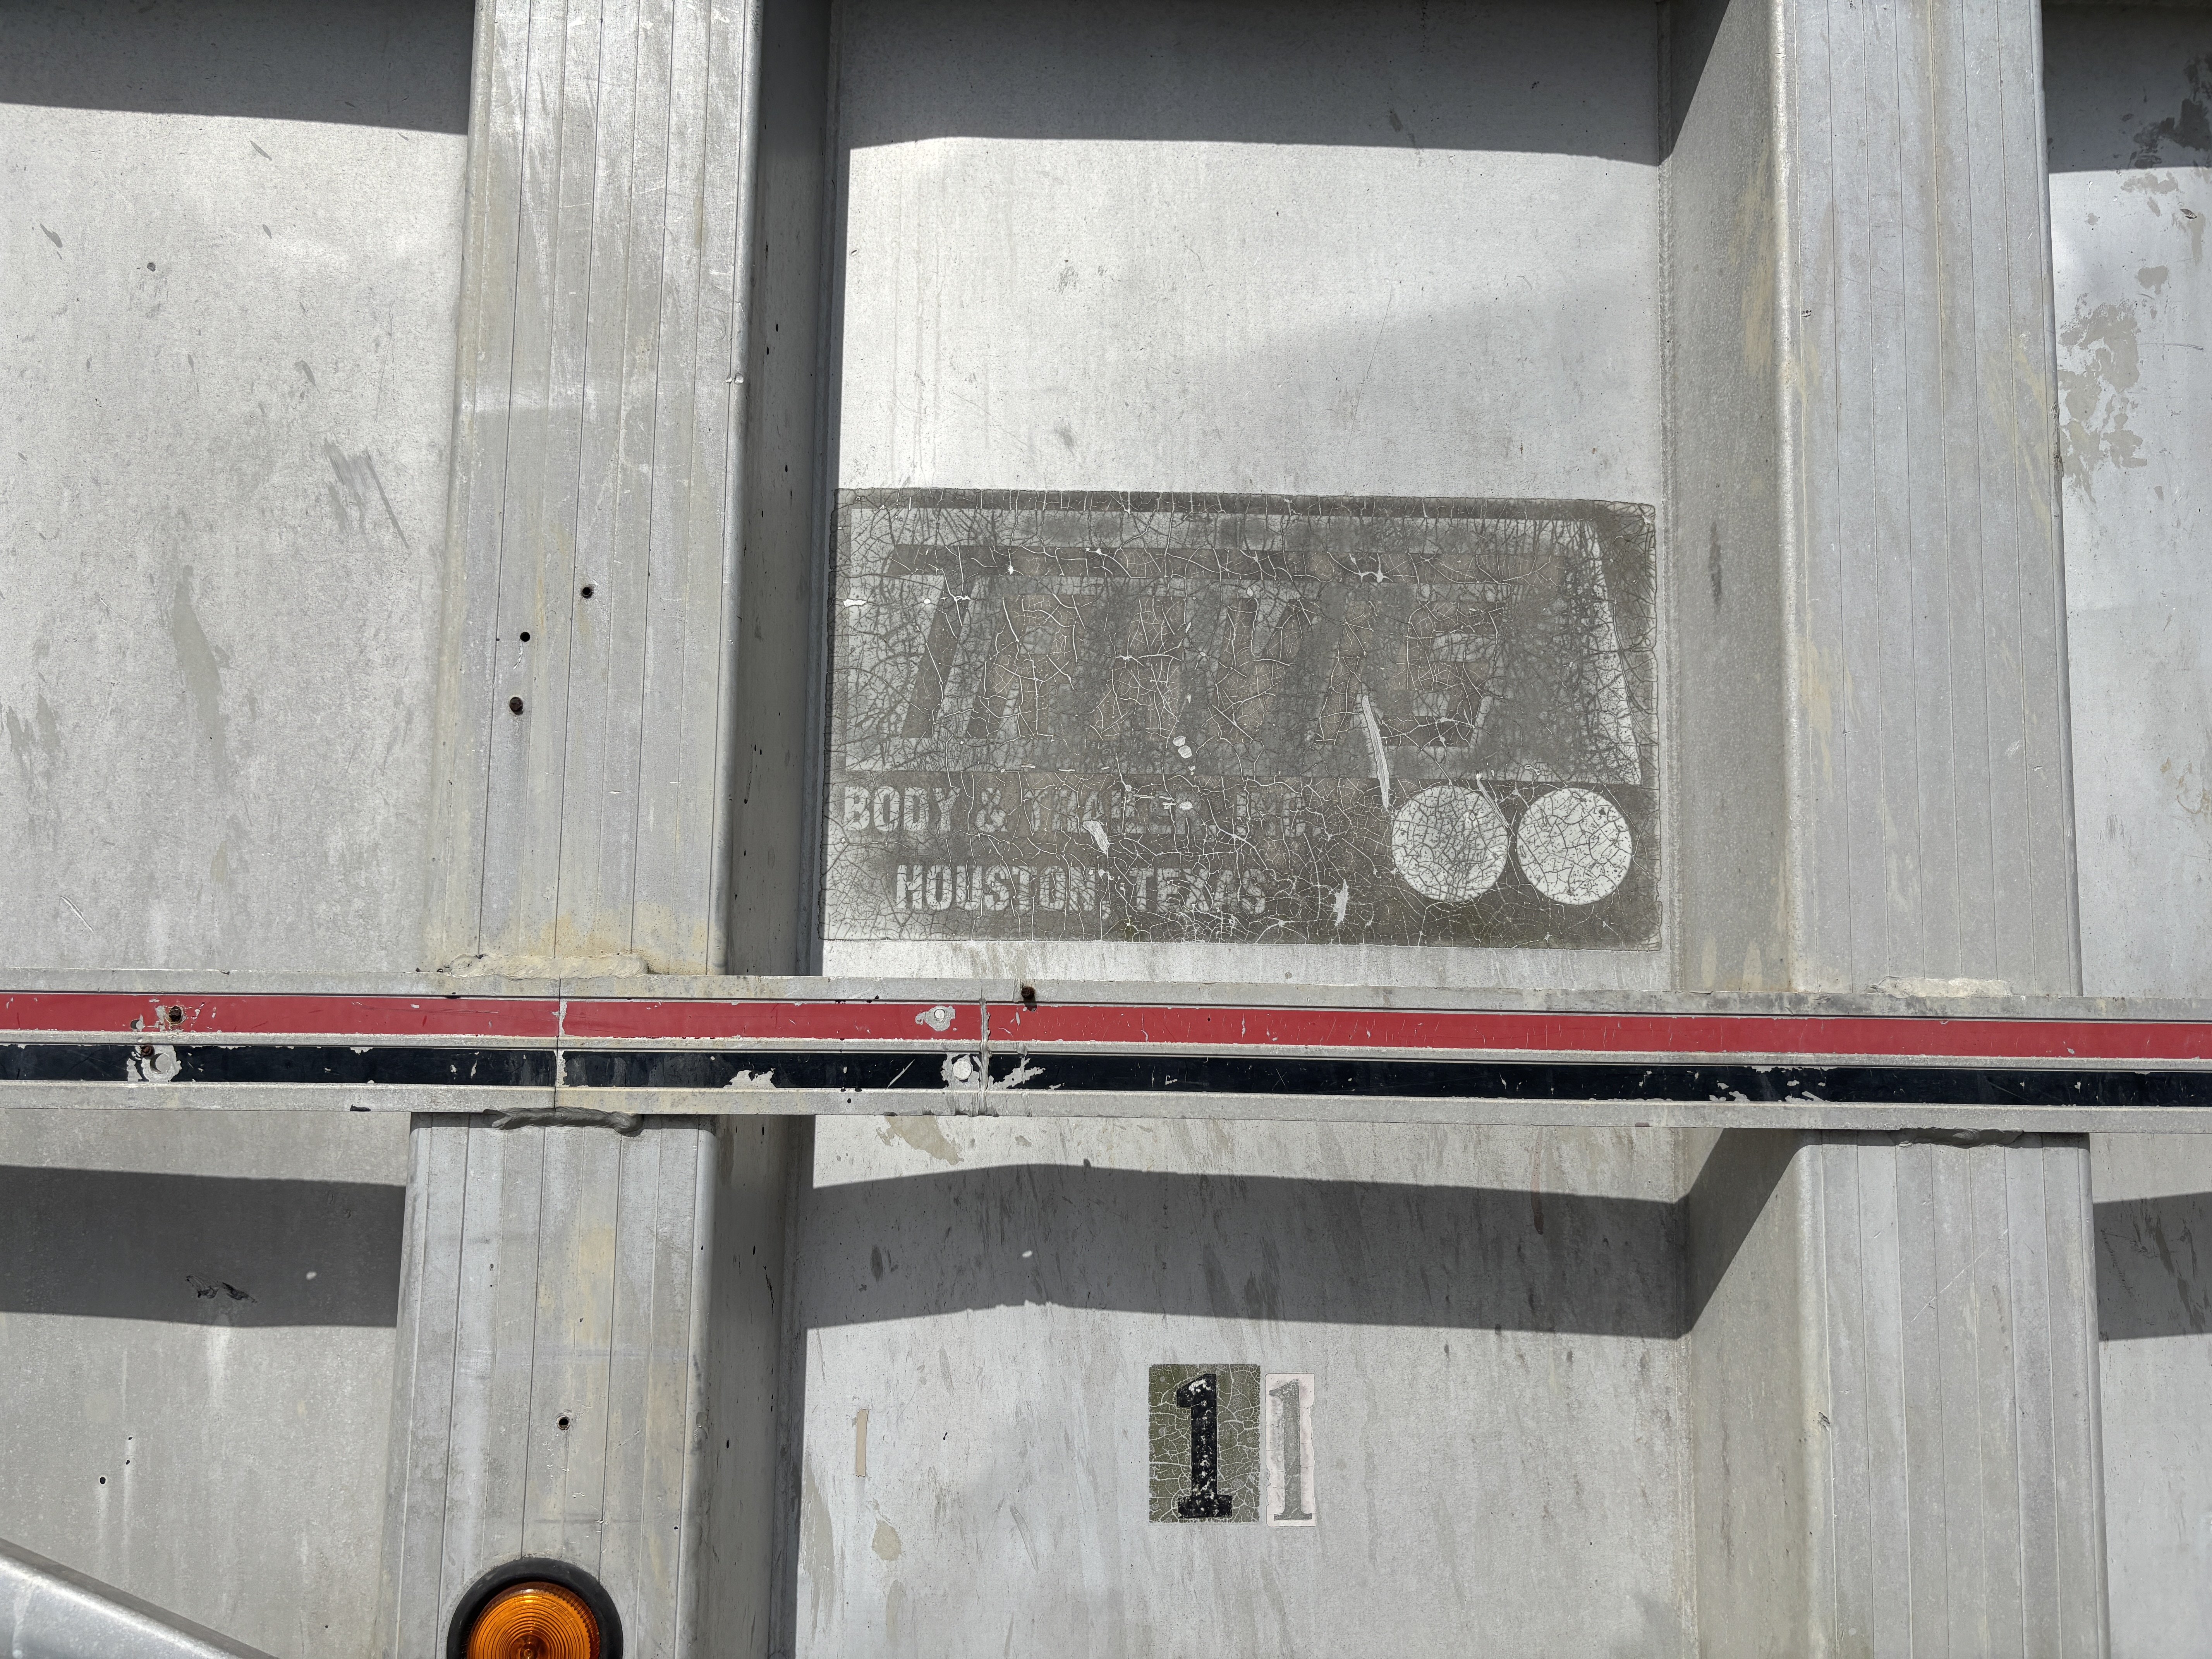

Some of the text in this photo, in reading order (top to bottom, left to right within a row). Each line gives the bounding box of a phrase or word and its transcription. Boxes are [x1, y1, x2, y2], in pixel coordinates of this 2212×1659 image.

[844, 786, 961, 831] BODY
[976, 788, 1008, 832] &
[1129, 867, 1266, 915] TEXAS
[1176, 1374, 1232, 1518] 1
[1269, 1379, 1313, 1521] 1
